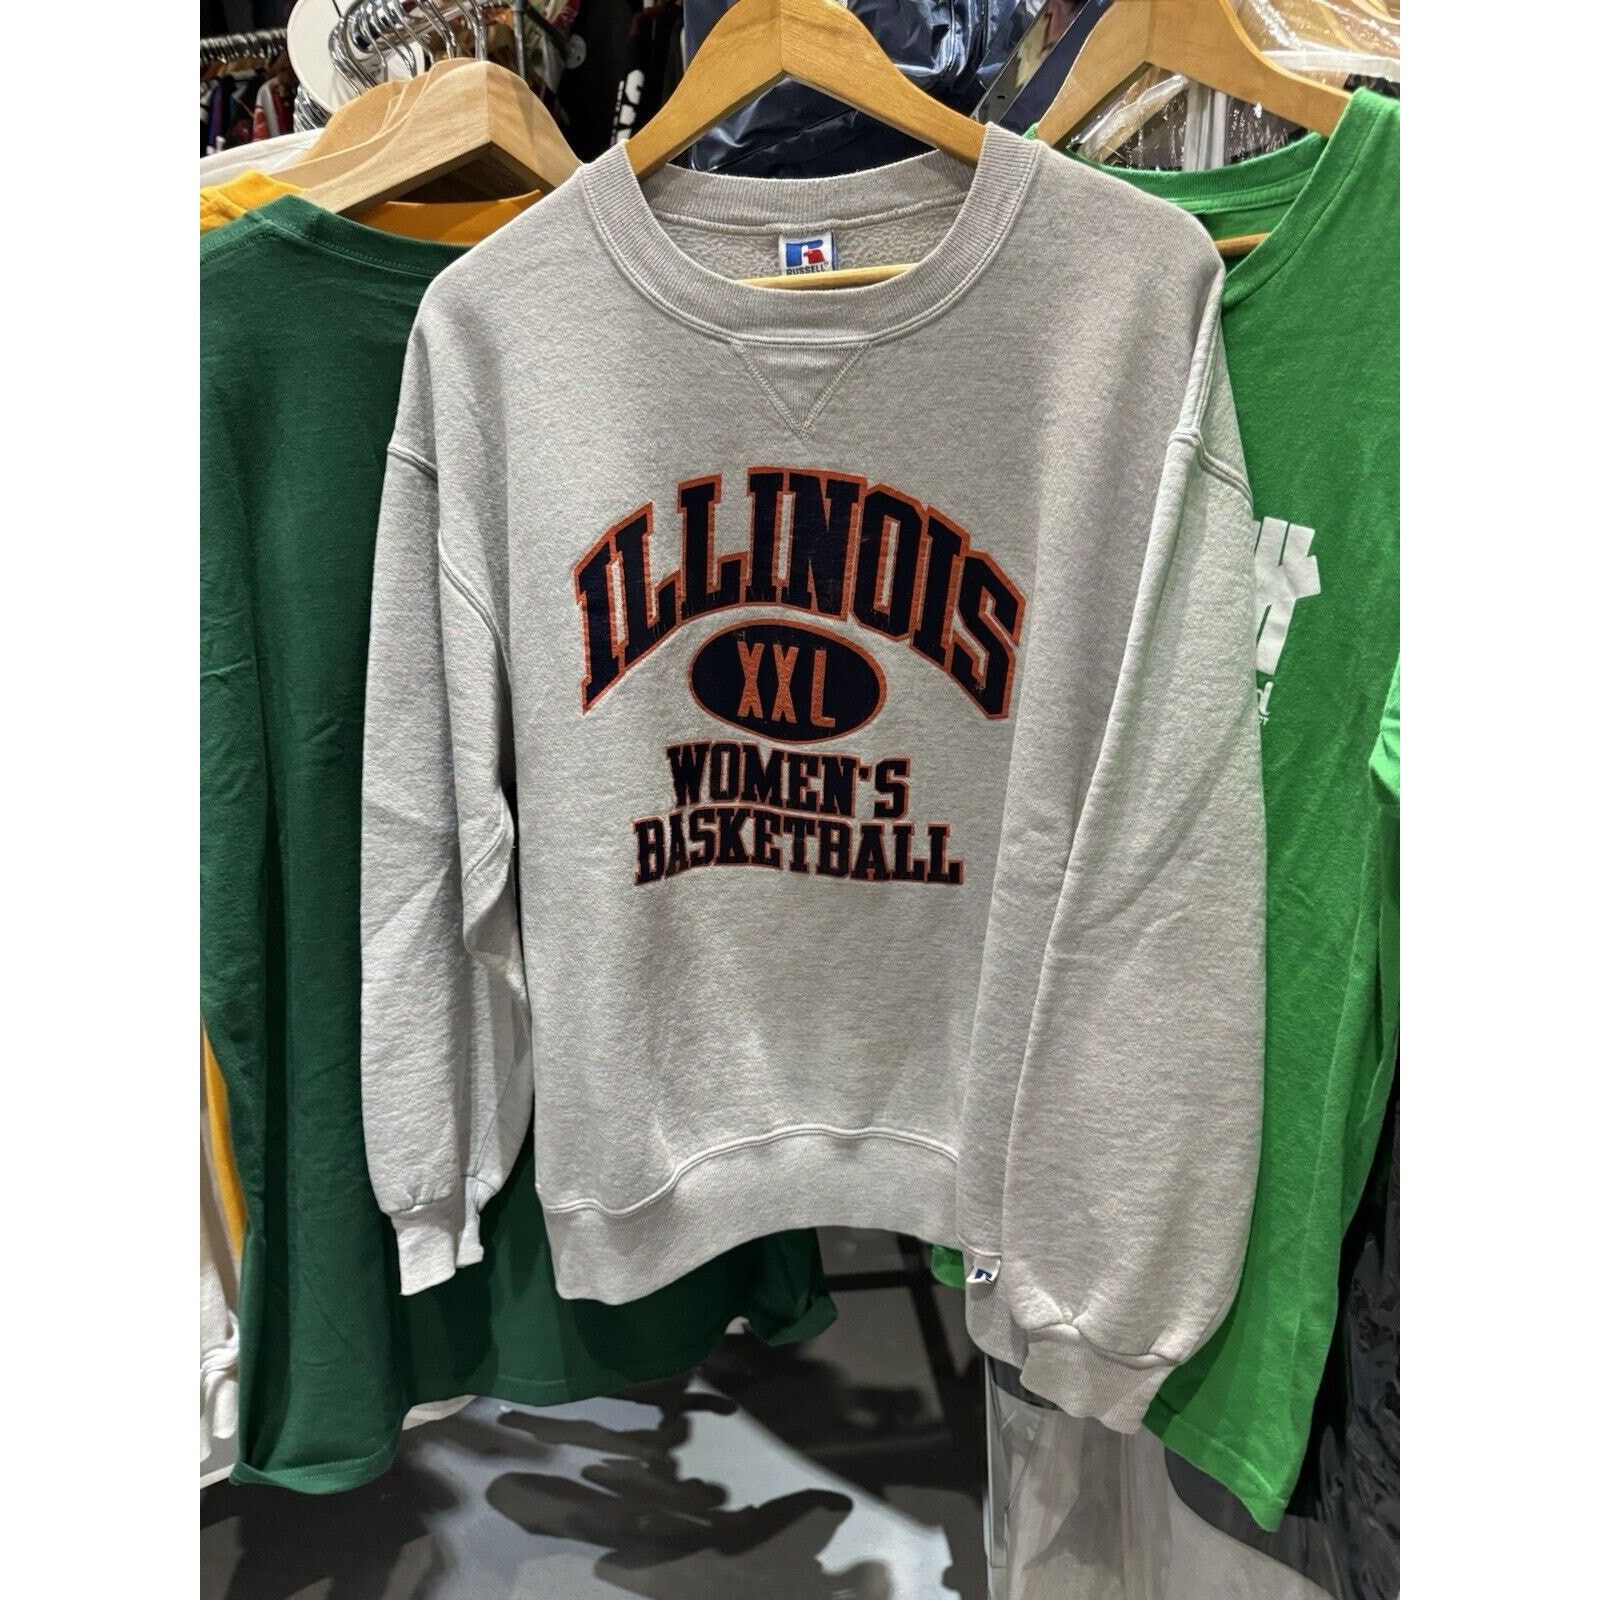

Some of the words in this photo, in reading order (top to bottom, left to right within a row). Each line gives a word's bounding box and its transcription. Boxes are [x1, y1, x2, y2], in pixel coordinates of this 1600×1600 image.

[573, 466, 1026, 720] ILLINOIS
[737, 641, 836, 728] XXL
[666, 741, 911, 819] WOMEN'S
[632, 808, 964, 887] BASKETBALL
